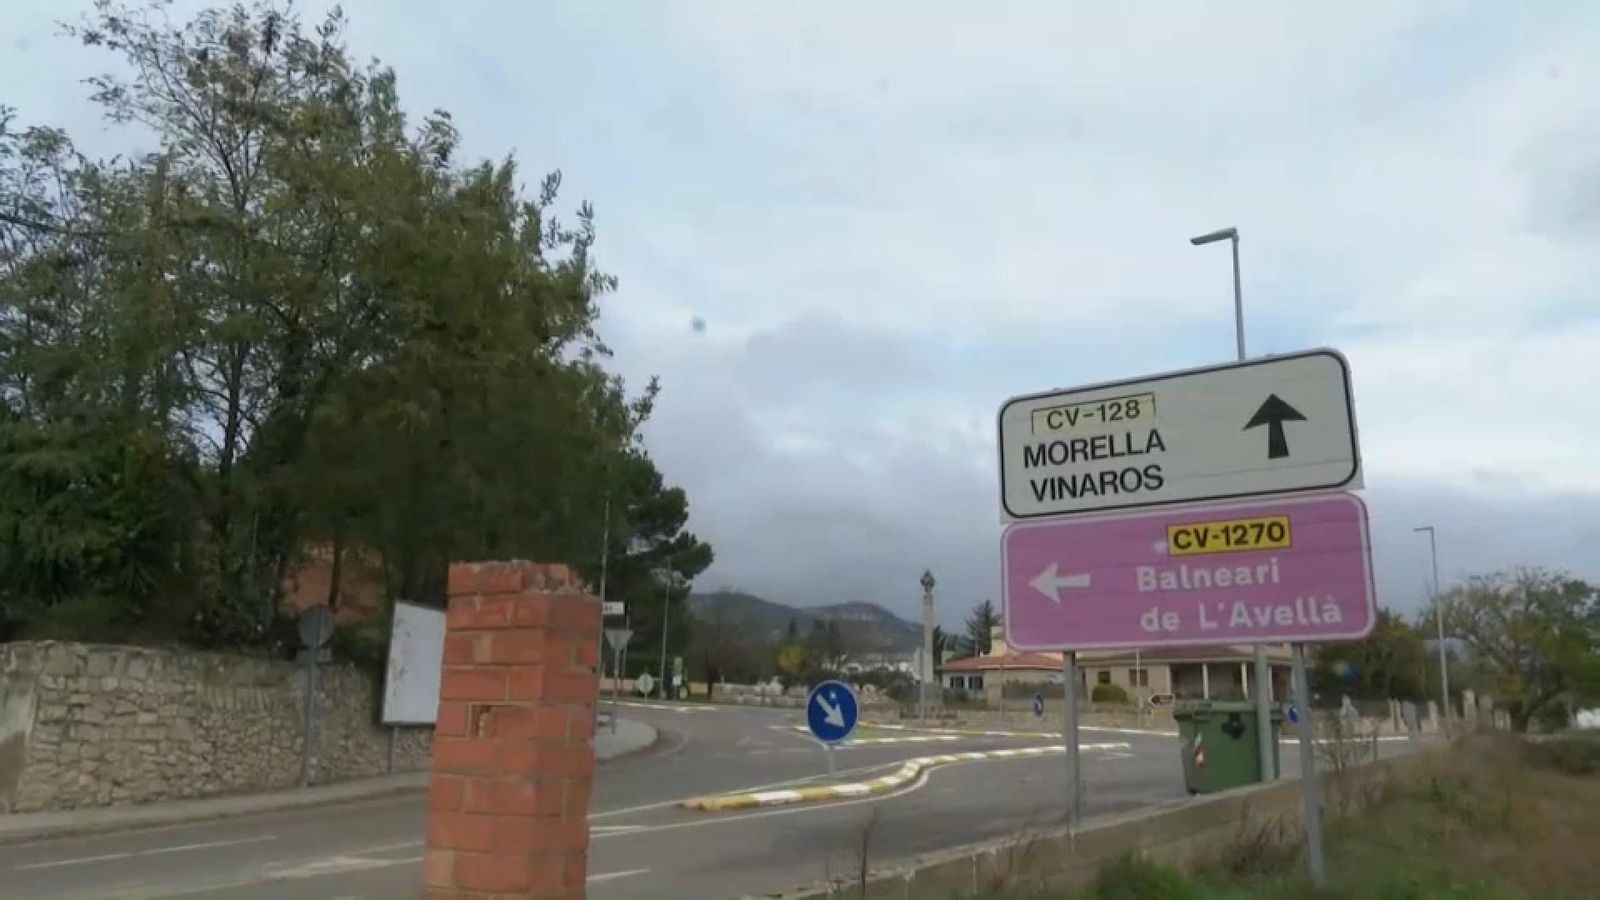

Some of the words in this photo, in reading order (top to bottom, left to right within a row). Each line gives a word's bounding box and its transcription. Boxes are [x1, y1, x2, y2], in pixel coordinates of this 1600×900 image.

[1046, 400, 1141, 430] CV-128
[1023, 429, 1166, 469] MORELLA
[1030, 465, 1164, 503] VINAROS
[1172, 521, 1286, 550] CV-1270
[1136, 558, 1281, 593] Balneari
[1141, 607, 1180, 632] de
[1198, 595, 1343, 629] L'Avellà
